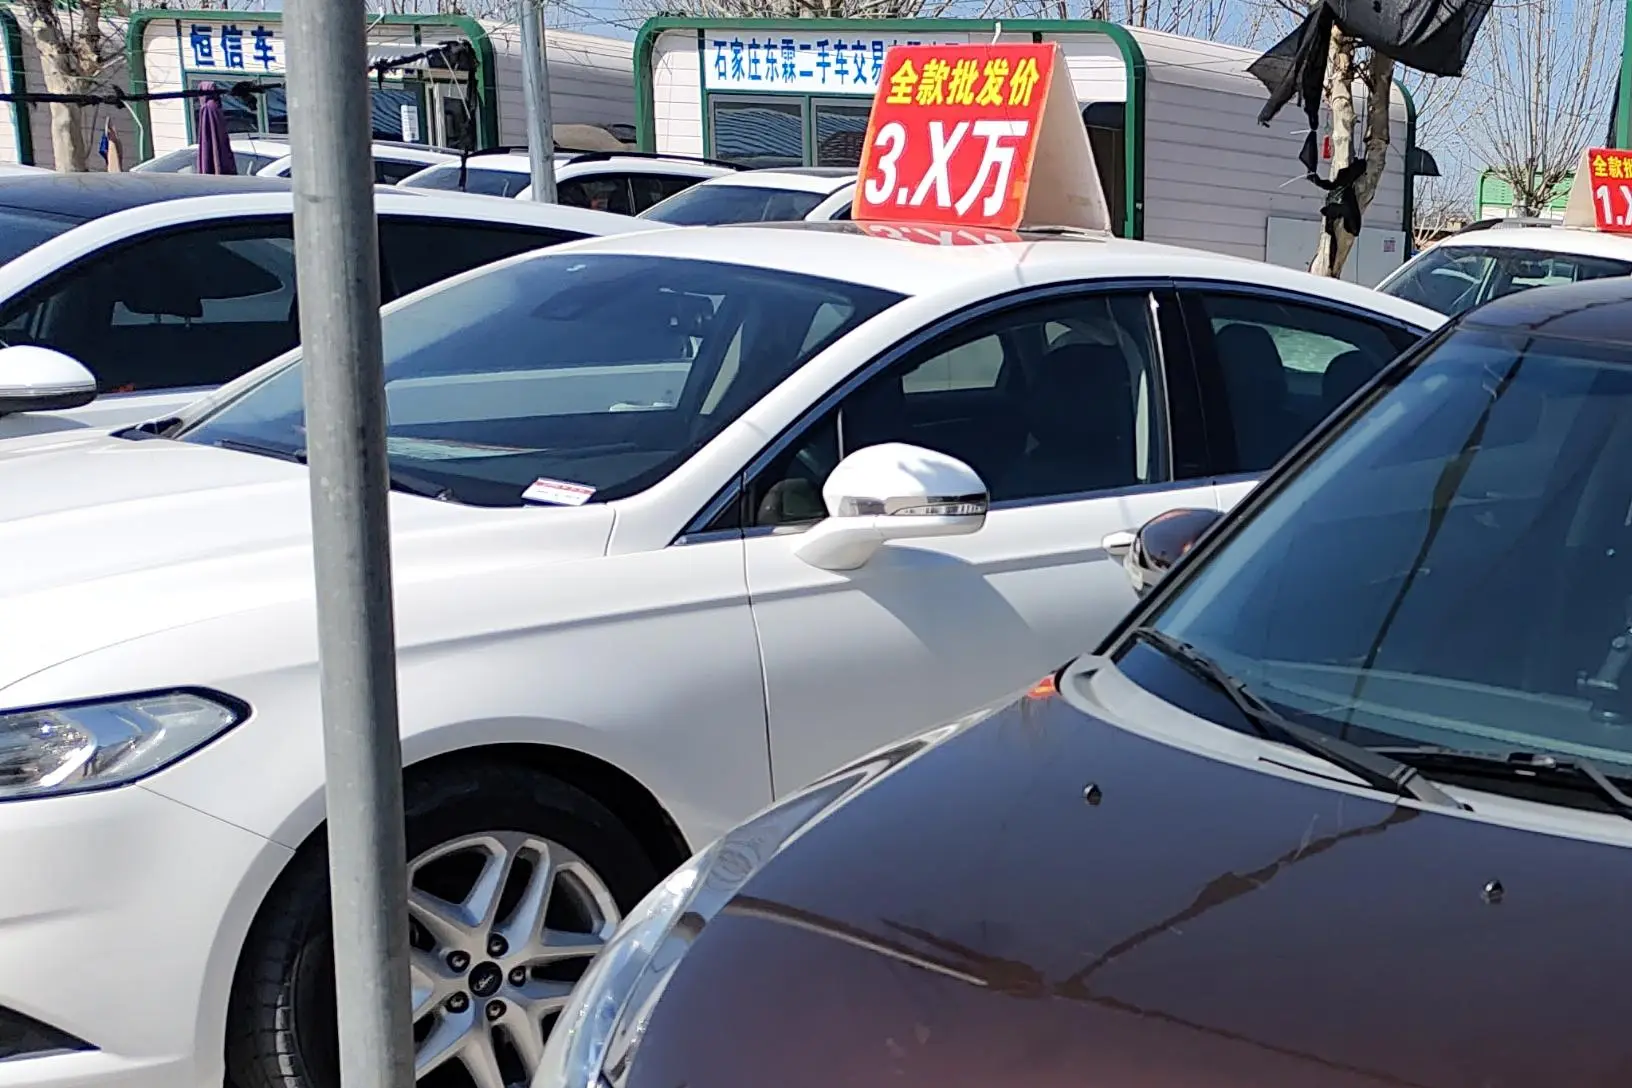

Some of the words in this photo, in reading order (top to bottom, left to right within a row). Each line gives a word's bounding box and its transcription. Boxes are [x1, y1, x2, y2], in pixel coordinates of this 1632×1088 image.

[190, 24, 277, 69] 恒信车
[713, 37, 958, 86] 石家庄东霖二手车交易
[886, 57, 1040, 107] 全款批发价
[864, 120, 1029, 217] 3.X万
